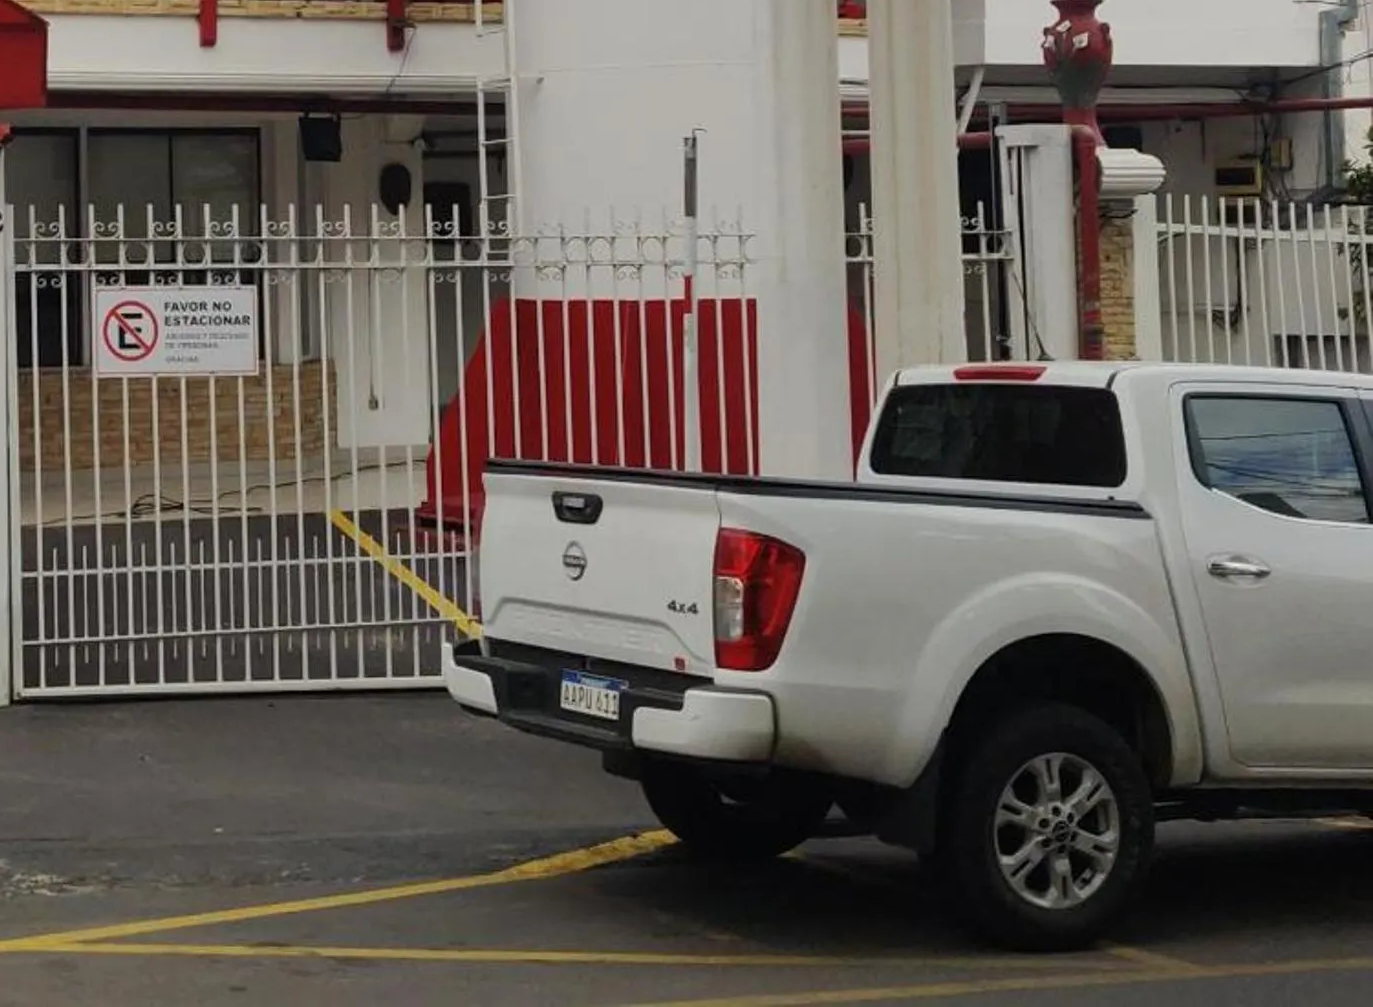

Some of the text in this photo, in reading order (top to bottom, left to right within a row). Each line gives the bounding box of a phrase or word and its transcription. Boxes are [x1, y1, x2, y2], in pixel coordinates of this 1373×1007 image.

[164, 301, 232, 312] FAVOR NO
[164, 315, 251, 326] ESTACIONAR
